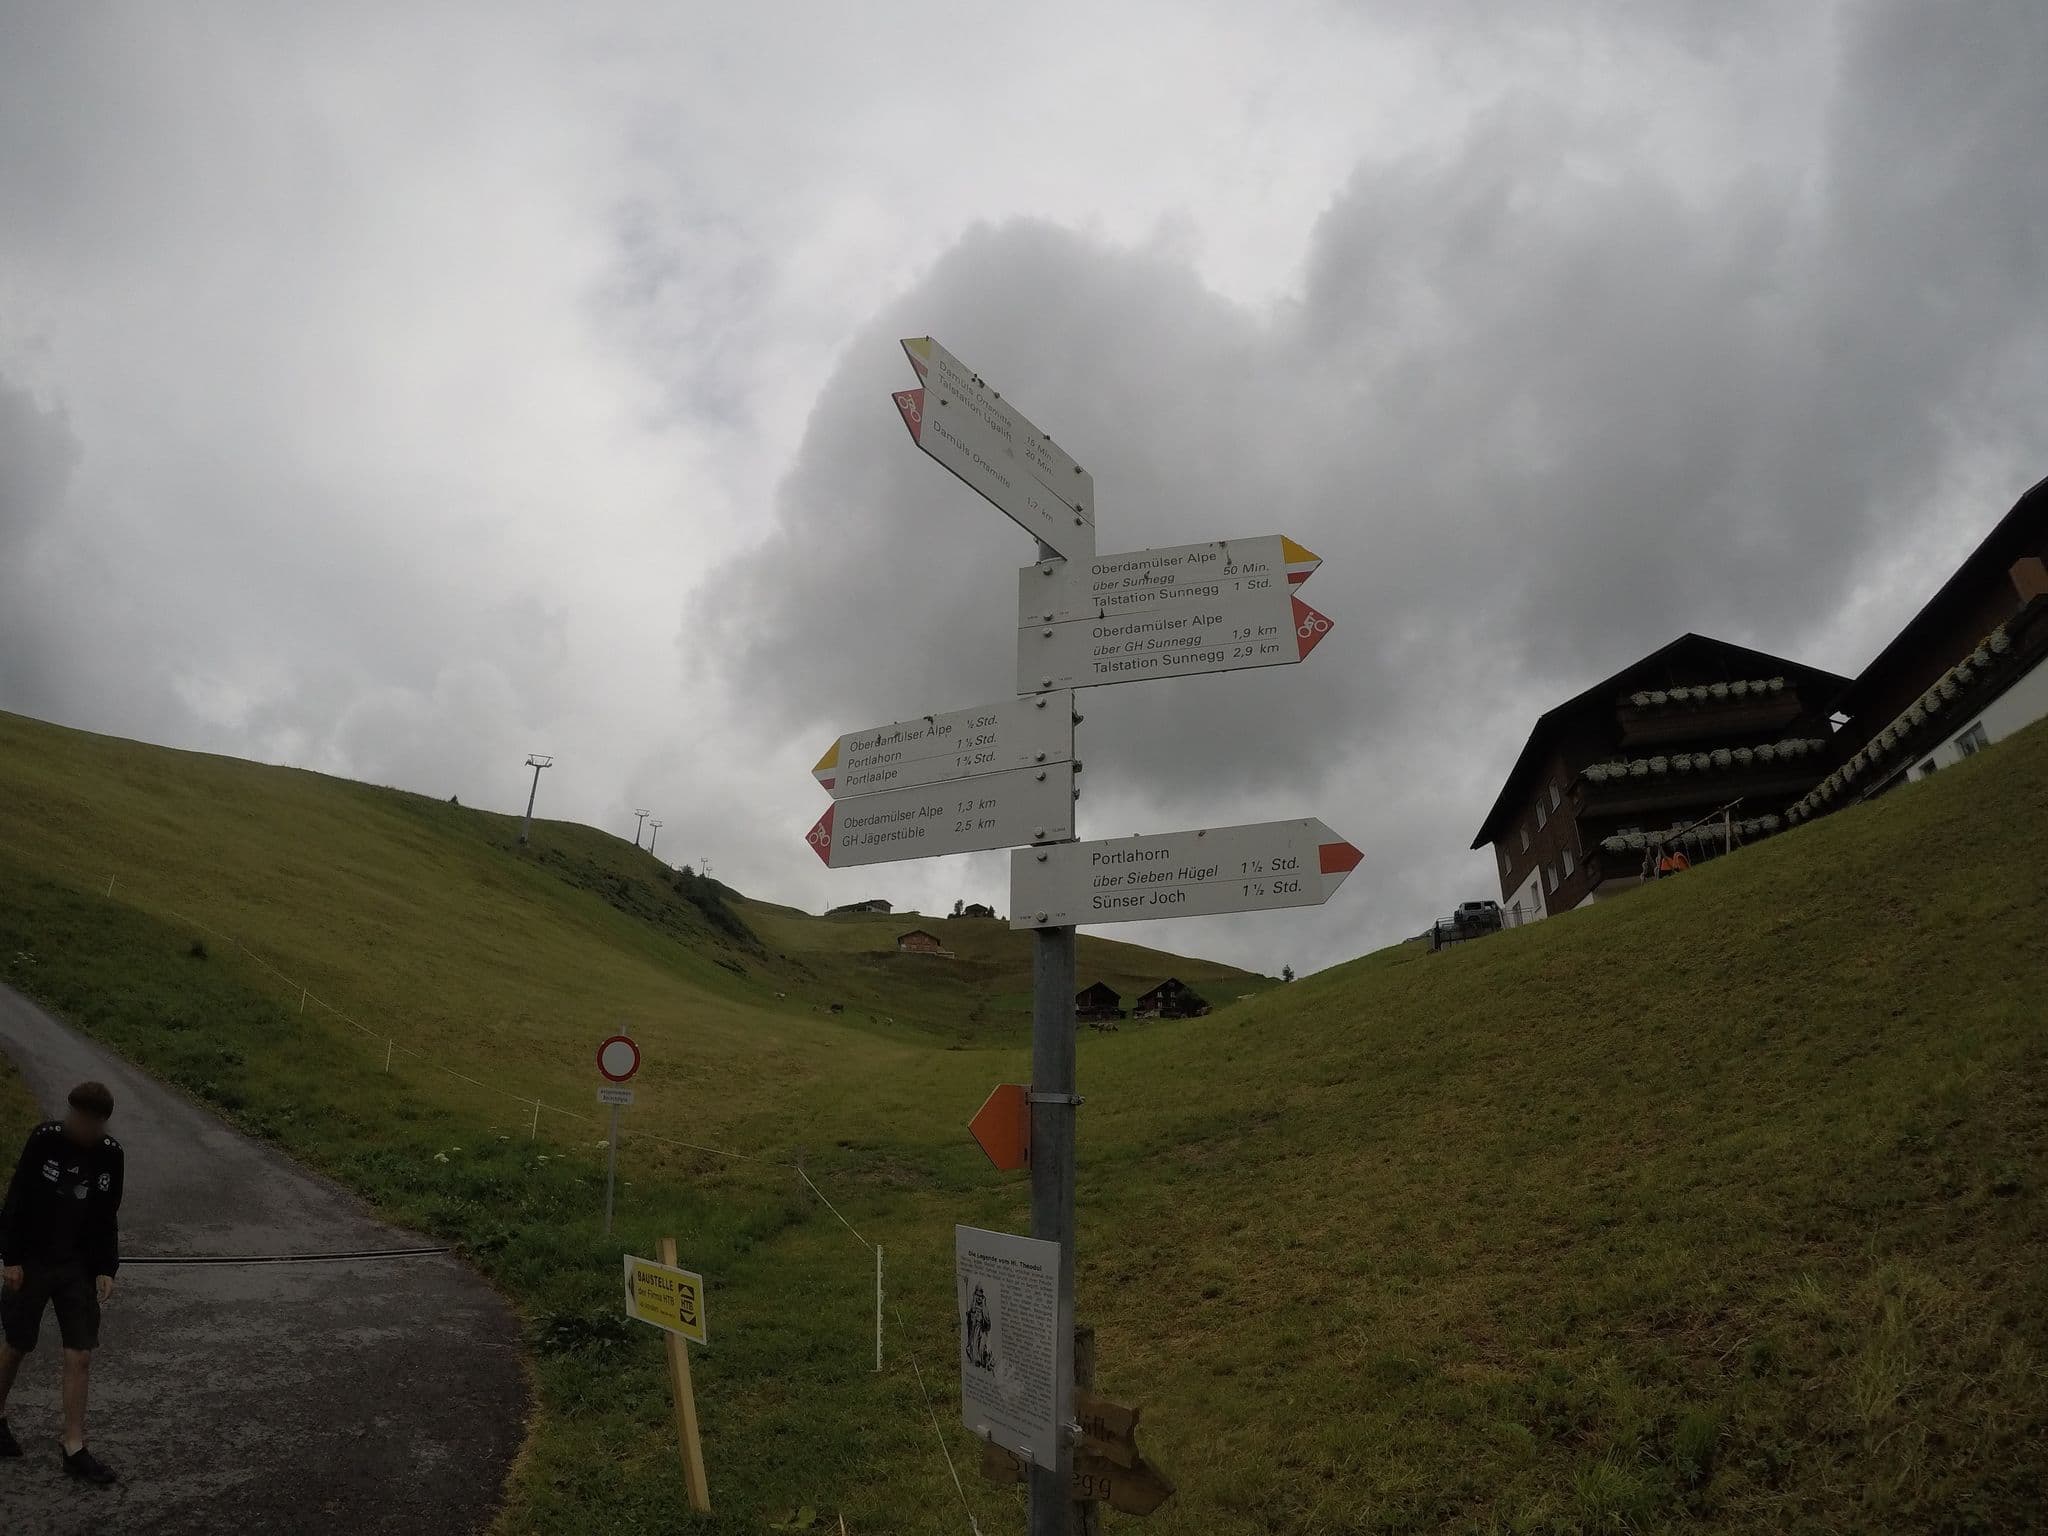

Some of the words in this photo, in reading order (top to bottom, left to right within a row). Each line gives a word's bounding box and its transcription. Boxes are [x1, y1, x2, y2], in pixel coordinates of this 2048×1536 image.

[938, 374, 981, 417] Talstation
[976, 393, 1012, 428] Ortsmitte
[933, 420, 971, 457] Damüls
[972, 454, 1011, 488] Ortsmitte
[1026, 435, 1035, 447] 15
[1037, 443, 1054, 464] Min.
[1025, 449, 1035, 461] 20
[1037, 457, 1054, 475] Min.
[1026, 496, 1039, 510] 1,7
[1041, 507, 1054, 523] km
[1091, 556, 1183, 576] Oberdamülser
[1187, 552, 1217, 567] Alpe
[1223, 565, 1239, 576] 50
[1242, 562, 1270, 574] Min.
[1092, 579, 1121, 593] über
[1122, 573, 1175, 590] Sunnegg
[1233, 581, 1240, 591] 1
[1247, 578, 1272, 590] Std.
[1092, 590, 1156, 608] Talstation
[1159, 584, 1219, 601] Sunnegg
[1092, 619, 1188, 640] Oberdamülser
[1191, 614, 1223, 629] Alpe
[1232, 628, 1251, 640] 1,9
[1257, 625, 1277, 637] km
[1093, 643, 1121, 657] über
[1124, 640, 1144, 653] GH
[1146, 634, 1202, 651] Sunnegg
[1232, 646, 1253, 658] 2,9
[1259, 642, 1280, 654] km
[1093, 656, 1158, 674] Talstation
[1162, 649, 1225, 666] Sunnegg
[976, 714, 998, 728] Std.
[926, 724, 953, 738] Alpe
[975, 732, 997, 746] Std.
[847, 751, 902, 769] Portlahorn
[974, 751, 996, 764] Std.
[846, 769, 898, 787] Portlaalpe
[919, 806, 943, 820] Alpe
[957, 800, 974, 813] 1,3
[978, 798, 996, 810] km
[954, 820, 972, 833] 2,5
[977, 818, 996, 830] km
[842, 834, 859, 847] GH
[860, 826, 926, 846] Jägerstüble
[1092, 848, 1170, 866] Portlahorn
[1271, 856, 1300, 871] Std.
[1093, 873, 1123, 888] über
[1127, 869, 1174, 885] Sieben
[1178, 865, 1218, 881] Hügel
[1273, 879, 1302, 894] Std.
[1092, 893, 1146, 910] Sünser
[1149, 890, 1186, 906] Joch
[977, 1253, 997, 1262] Legende
[998, 1257, 1010, 1265] vom
[637, 1271, 674, 1292] BAUSTELLE
[663, 1295, 675, 1306] HTB
[681, 1298, 694, 1311] HTB
